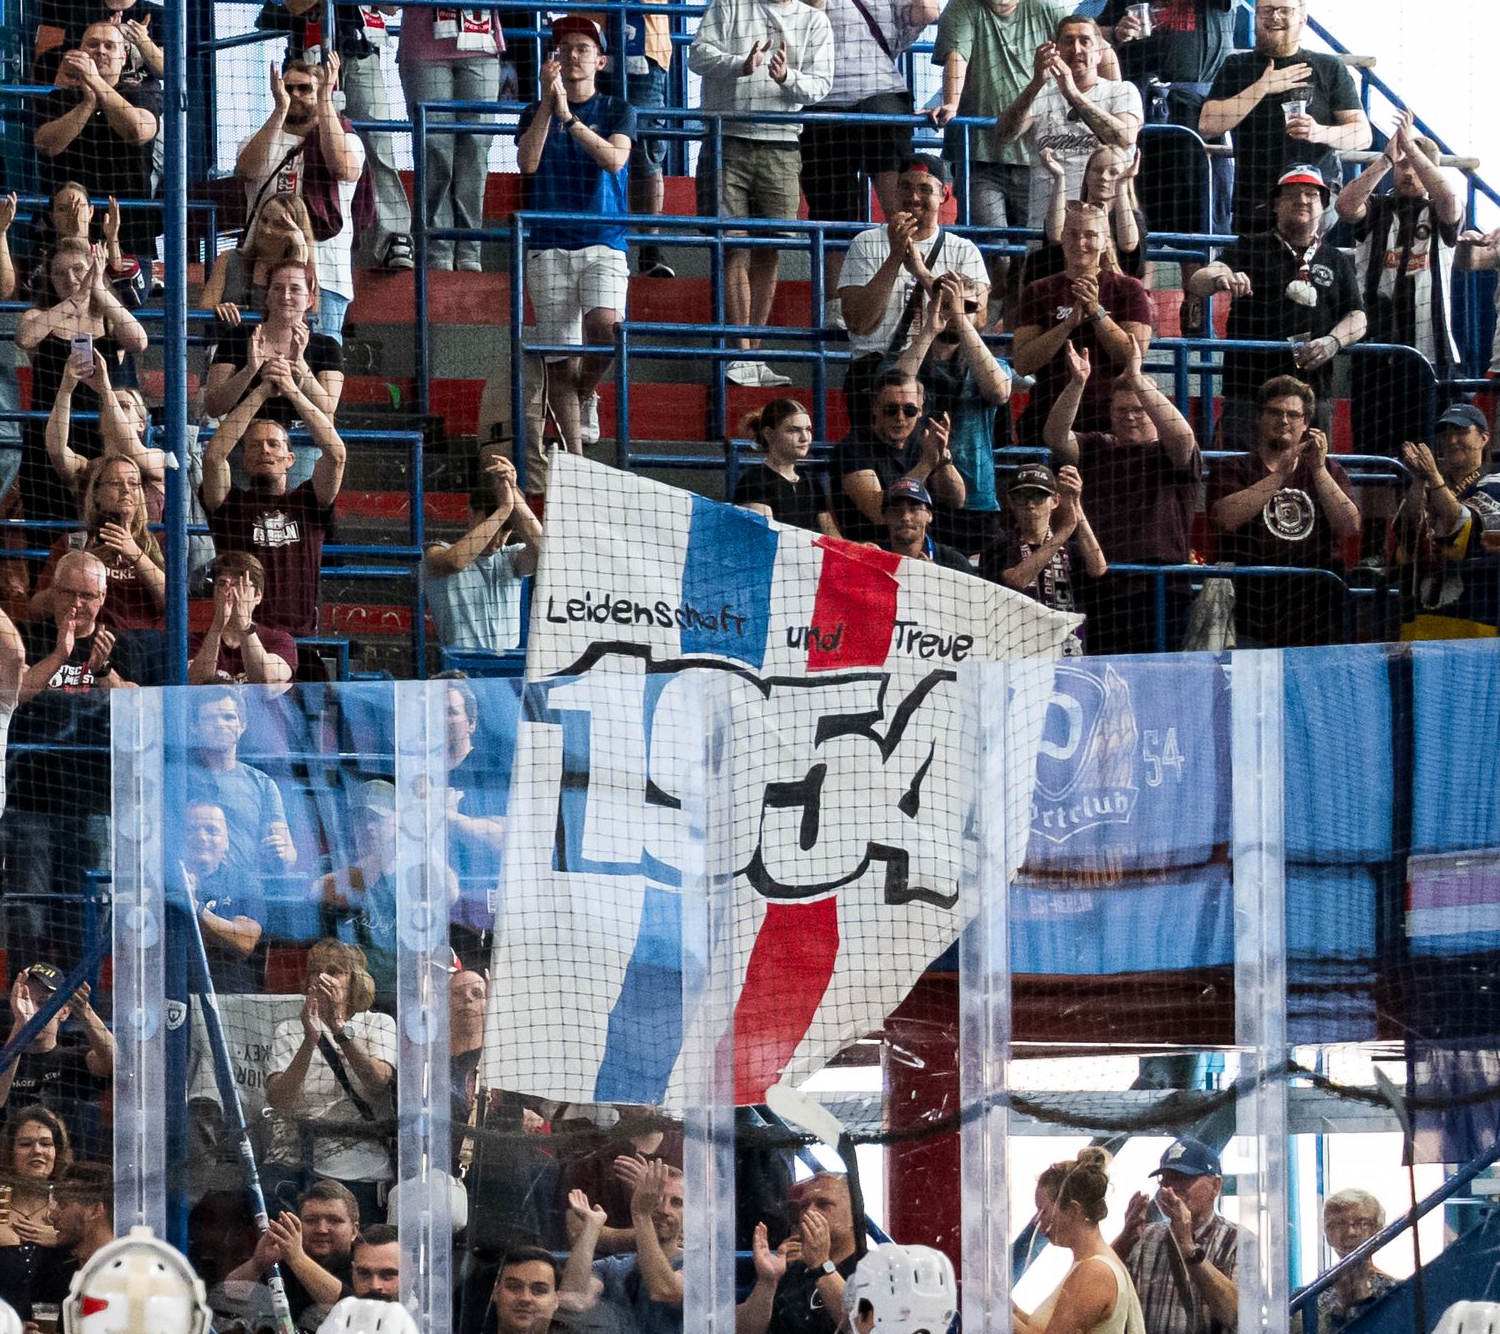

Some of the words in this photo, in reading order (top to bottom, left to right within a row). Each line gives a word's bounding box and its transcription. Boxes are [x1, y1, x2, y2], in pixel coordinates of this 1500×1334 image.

[546, 594, 746, 630] Leidenschaft
[788, 621, 842, 654] und
[894, 619, 975, 663] Treue
